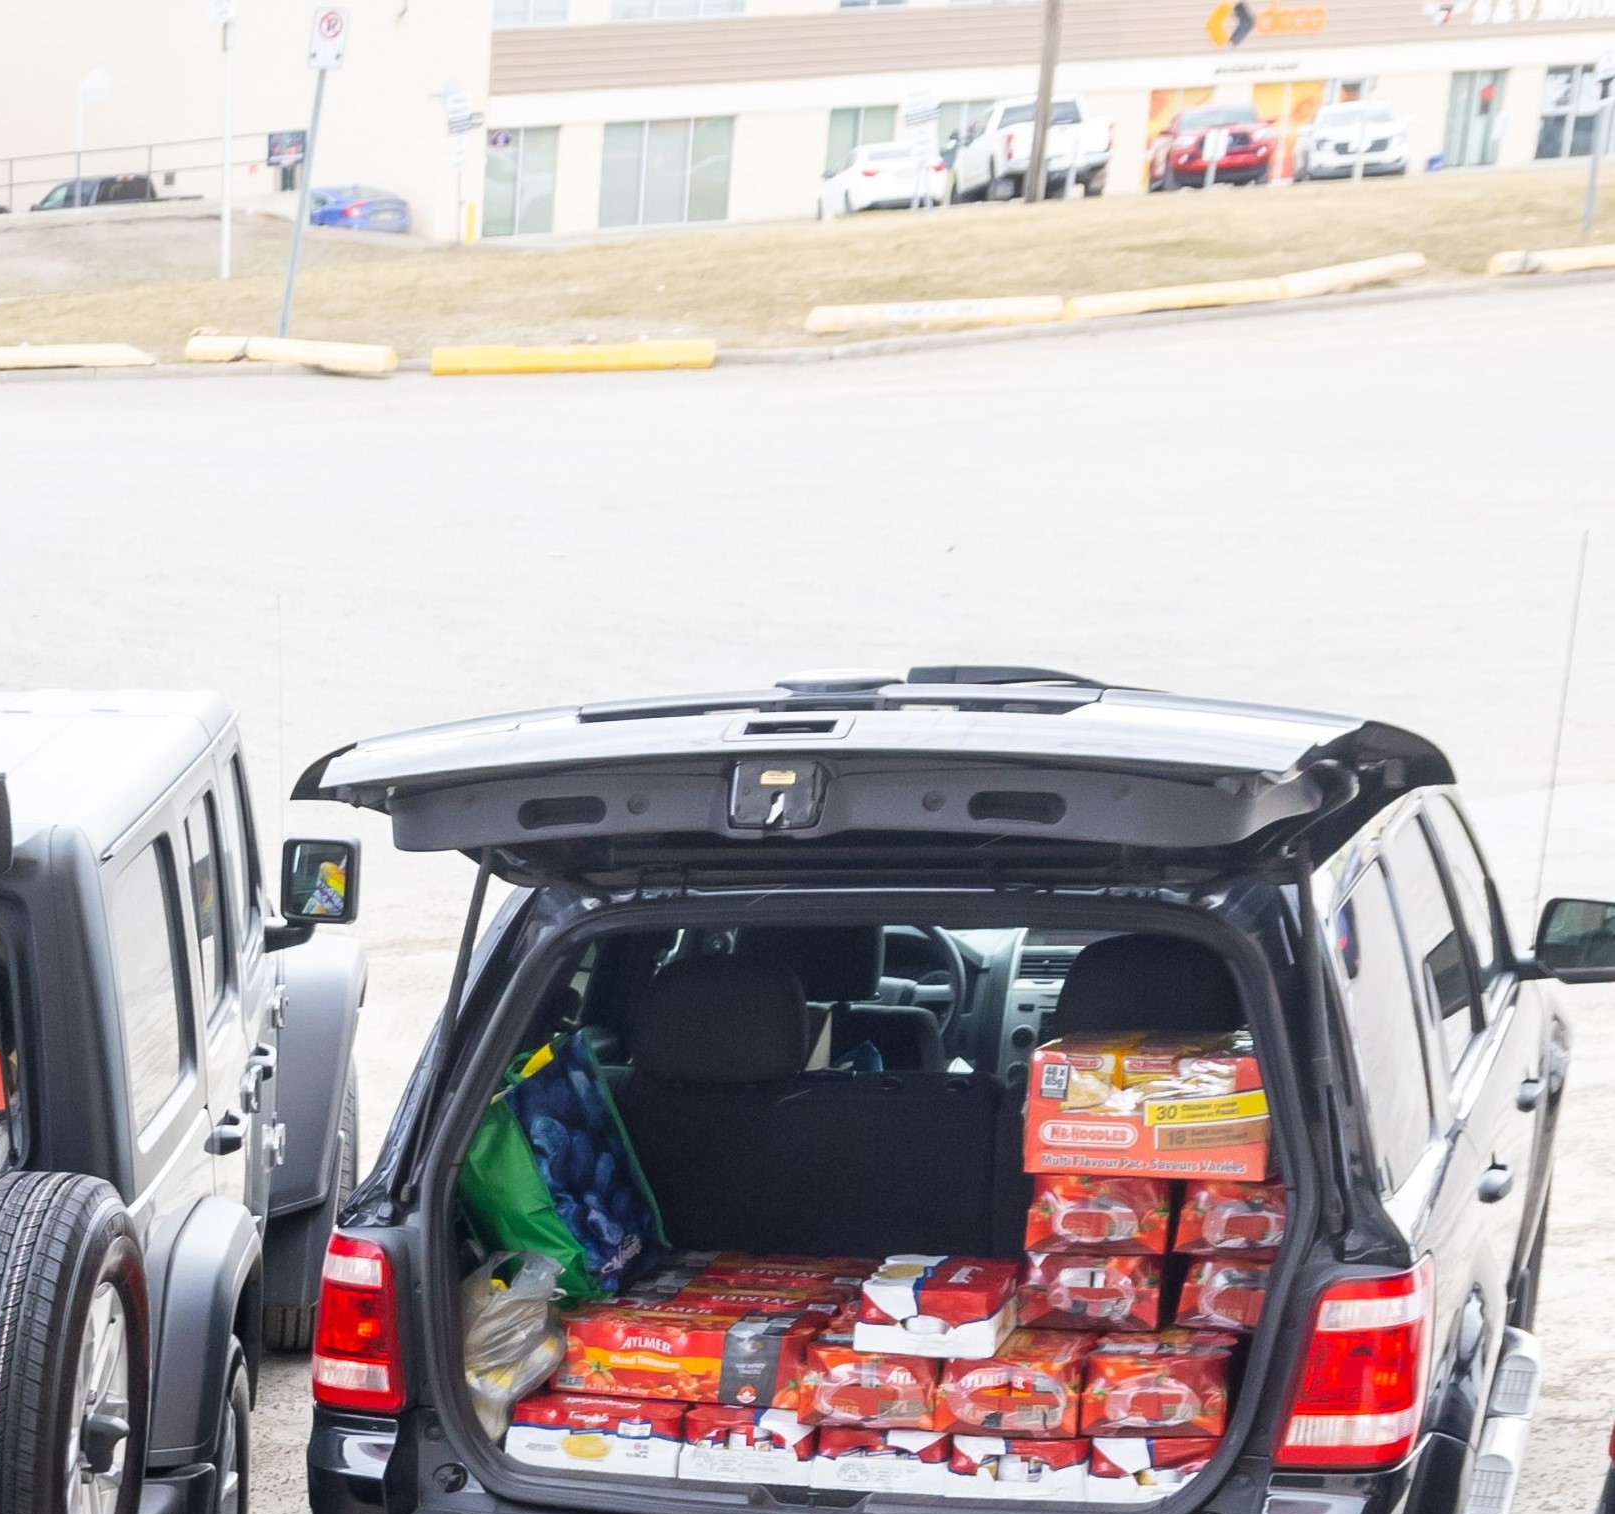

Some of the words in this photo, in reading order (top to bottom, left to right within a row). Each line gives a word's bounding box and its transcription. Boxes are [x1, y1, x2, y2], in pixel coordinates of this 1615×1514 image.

[1155, 1105, 1178, 1120] 30
[1040, 1154, 1069, 1166] Multi
[1071, 1155, 1119, 1169] Flavour
[1150, 1158, 1198, 1172] Saveurs
[621, 1335, 672, 1354] AYLMER
